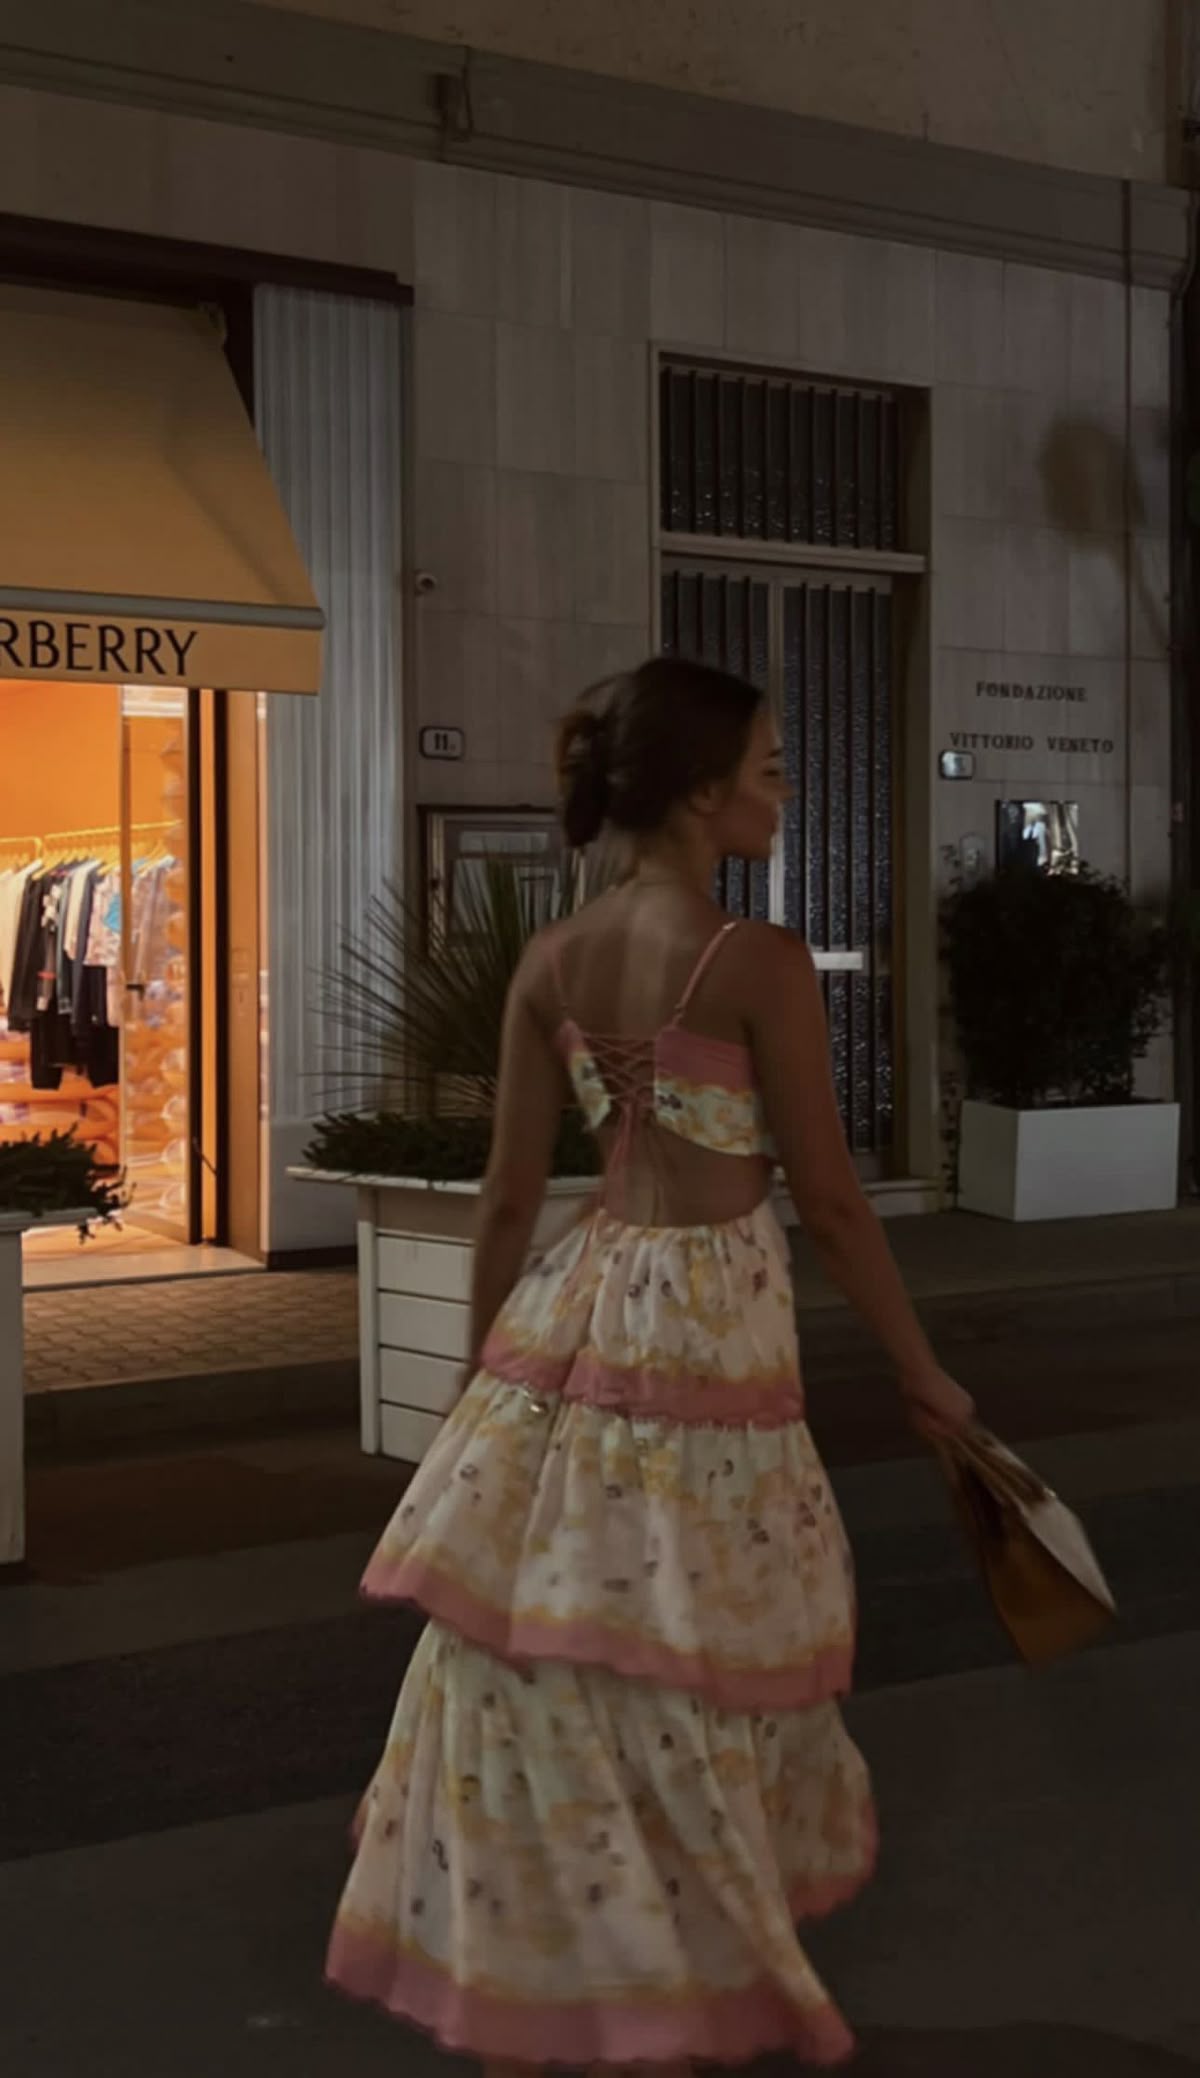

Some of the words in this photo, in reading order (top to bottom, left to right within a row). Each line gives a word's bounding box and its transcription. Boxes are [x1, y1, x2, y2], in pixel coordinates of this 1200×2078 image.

[976, 681, 1087, 702] FONDAZIONE
[950, 732, 1034, 751] VITTORIO
[1046, 736, 1115, 754] VENETO
